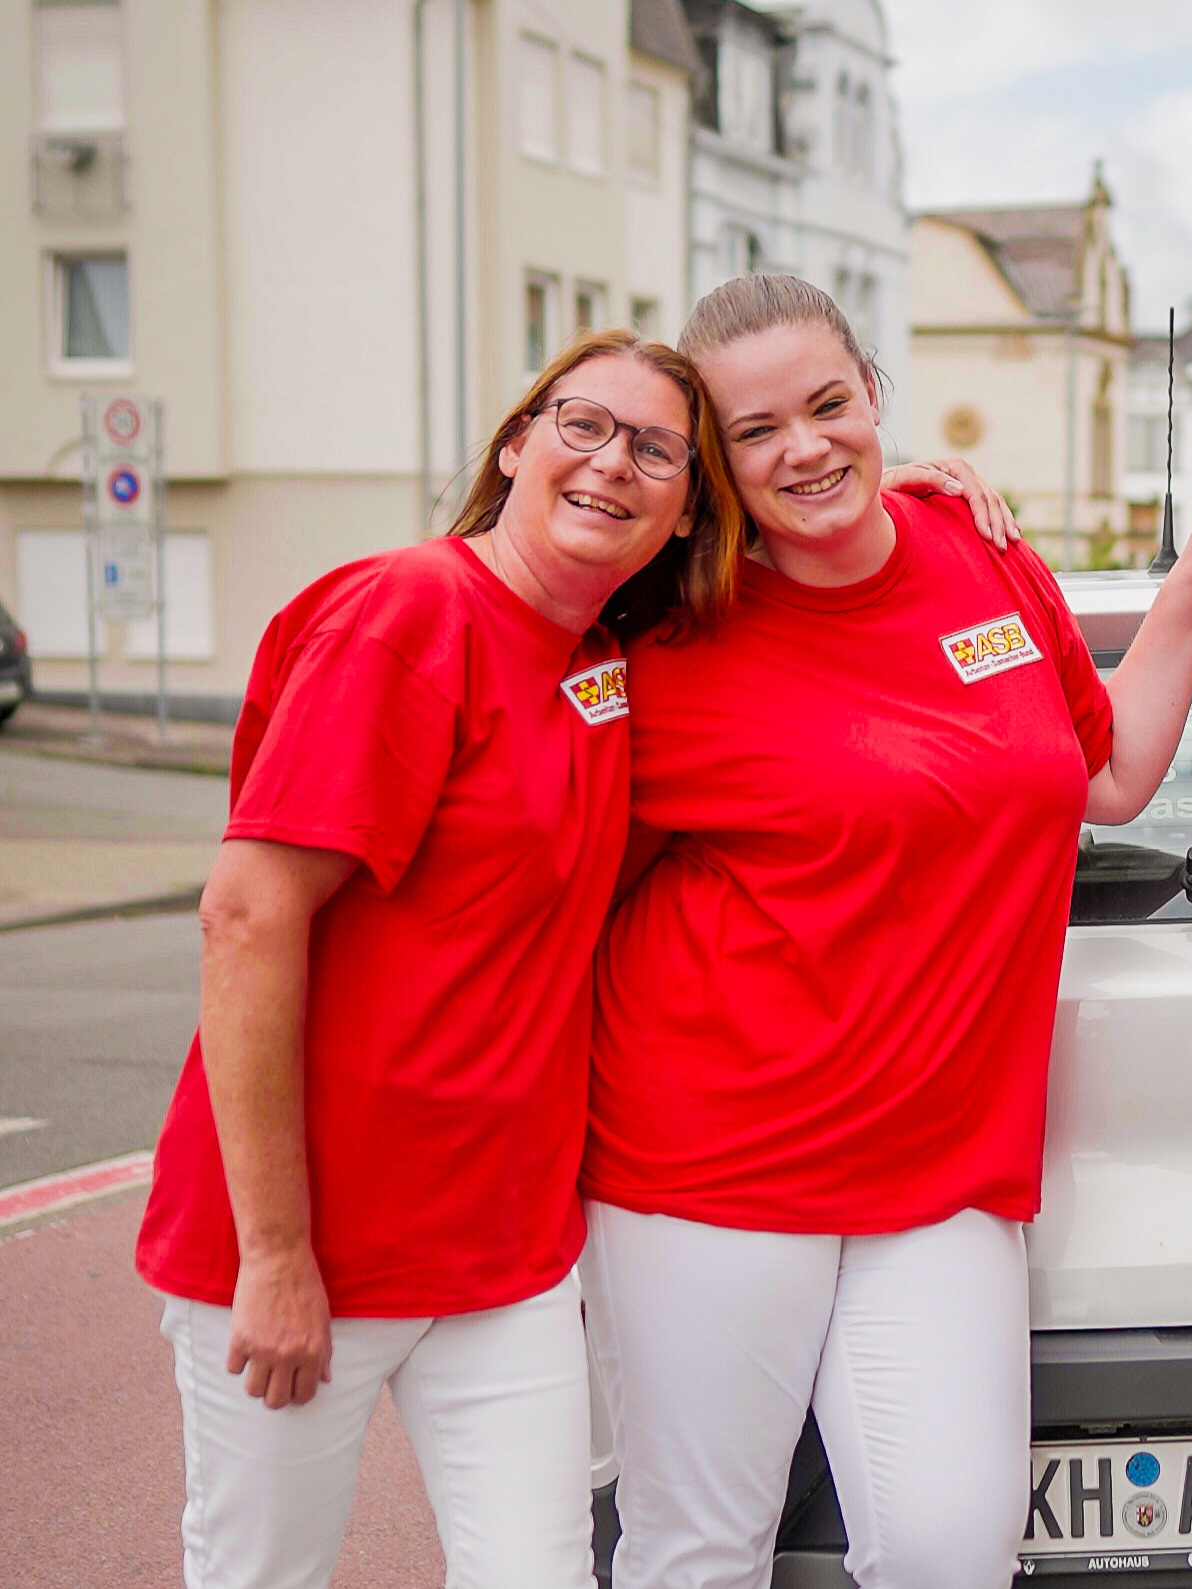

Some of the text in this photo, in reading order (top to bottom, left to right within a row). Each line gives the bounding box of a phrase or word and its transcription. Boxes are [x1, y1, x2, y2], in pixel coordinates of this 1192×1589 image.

[977, 622, 1026, 662] ASB
[601, 667, 627, 702] AS
[1023, 1458, 1113, 1540] KH
[1088, 1556, 1150, 1570] AUTOHAUS
